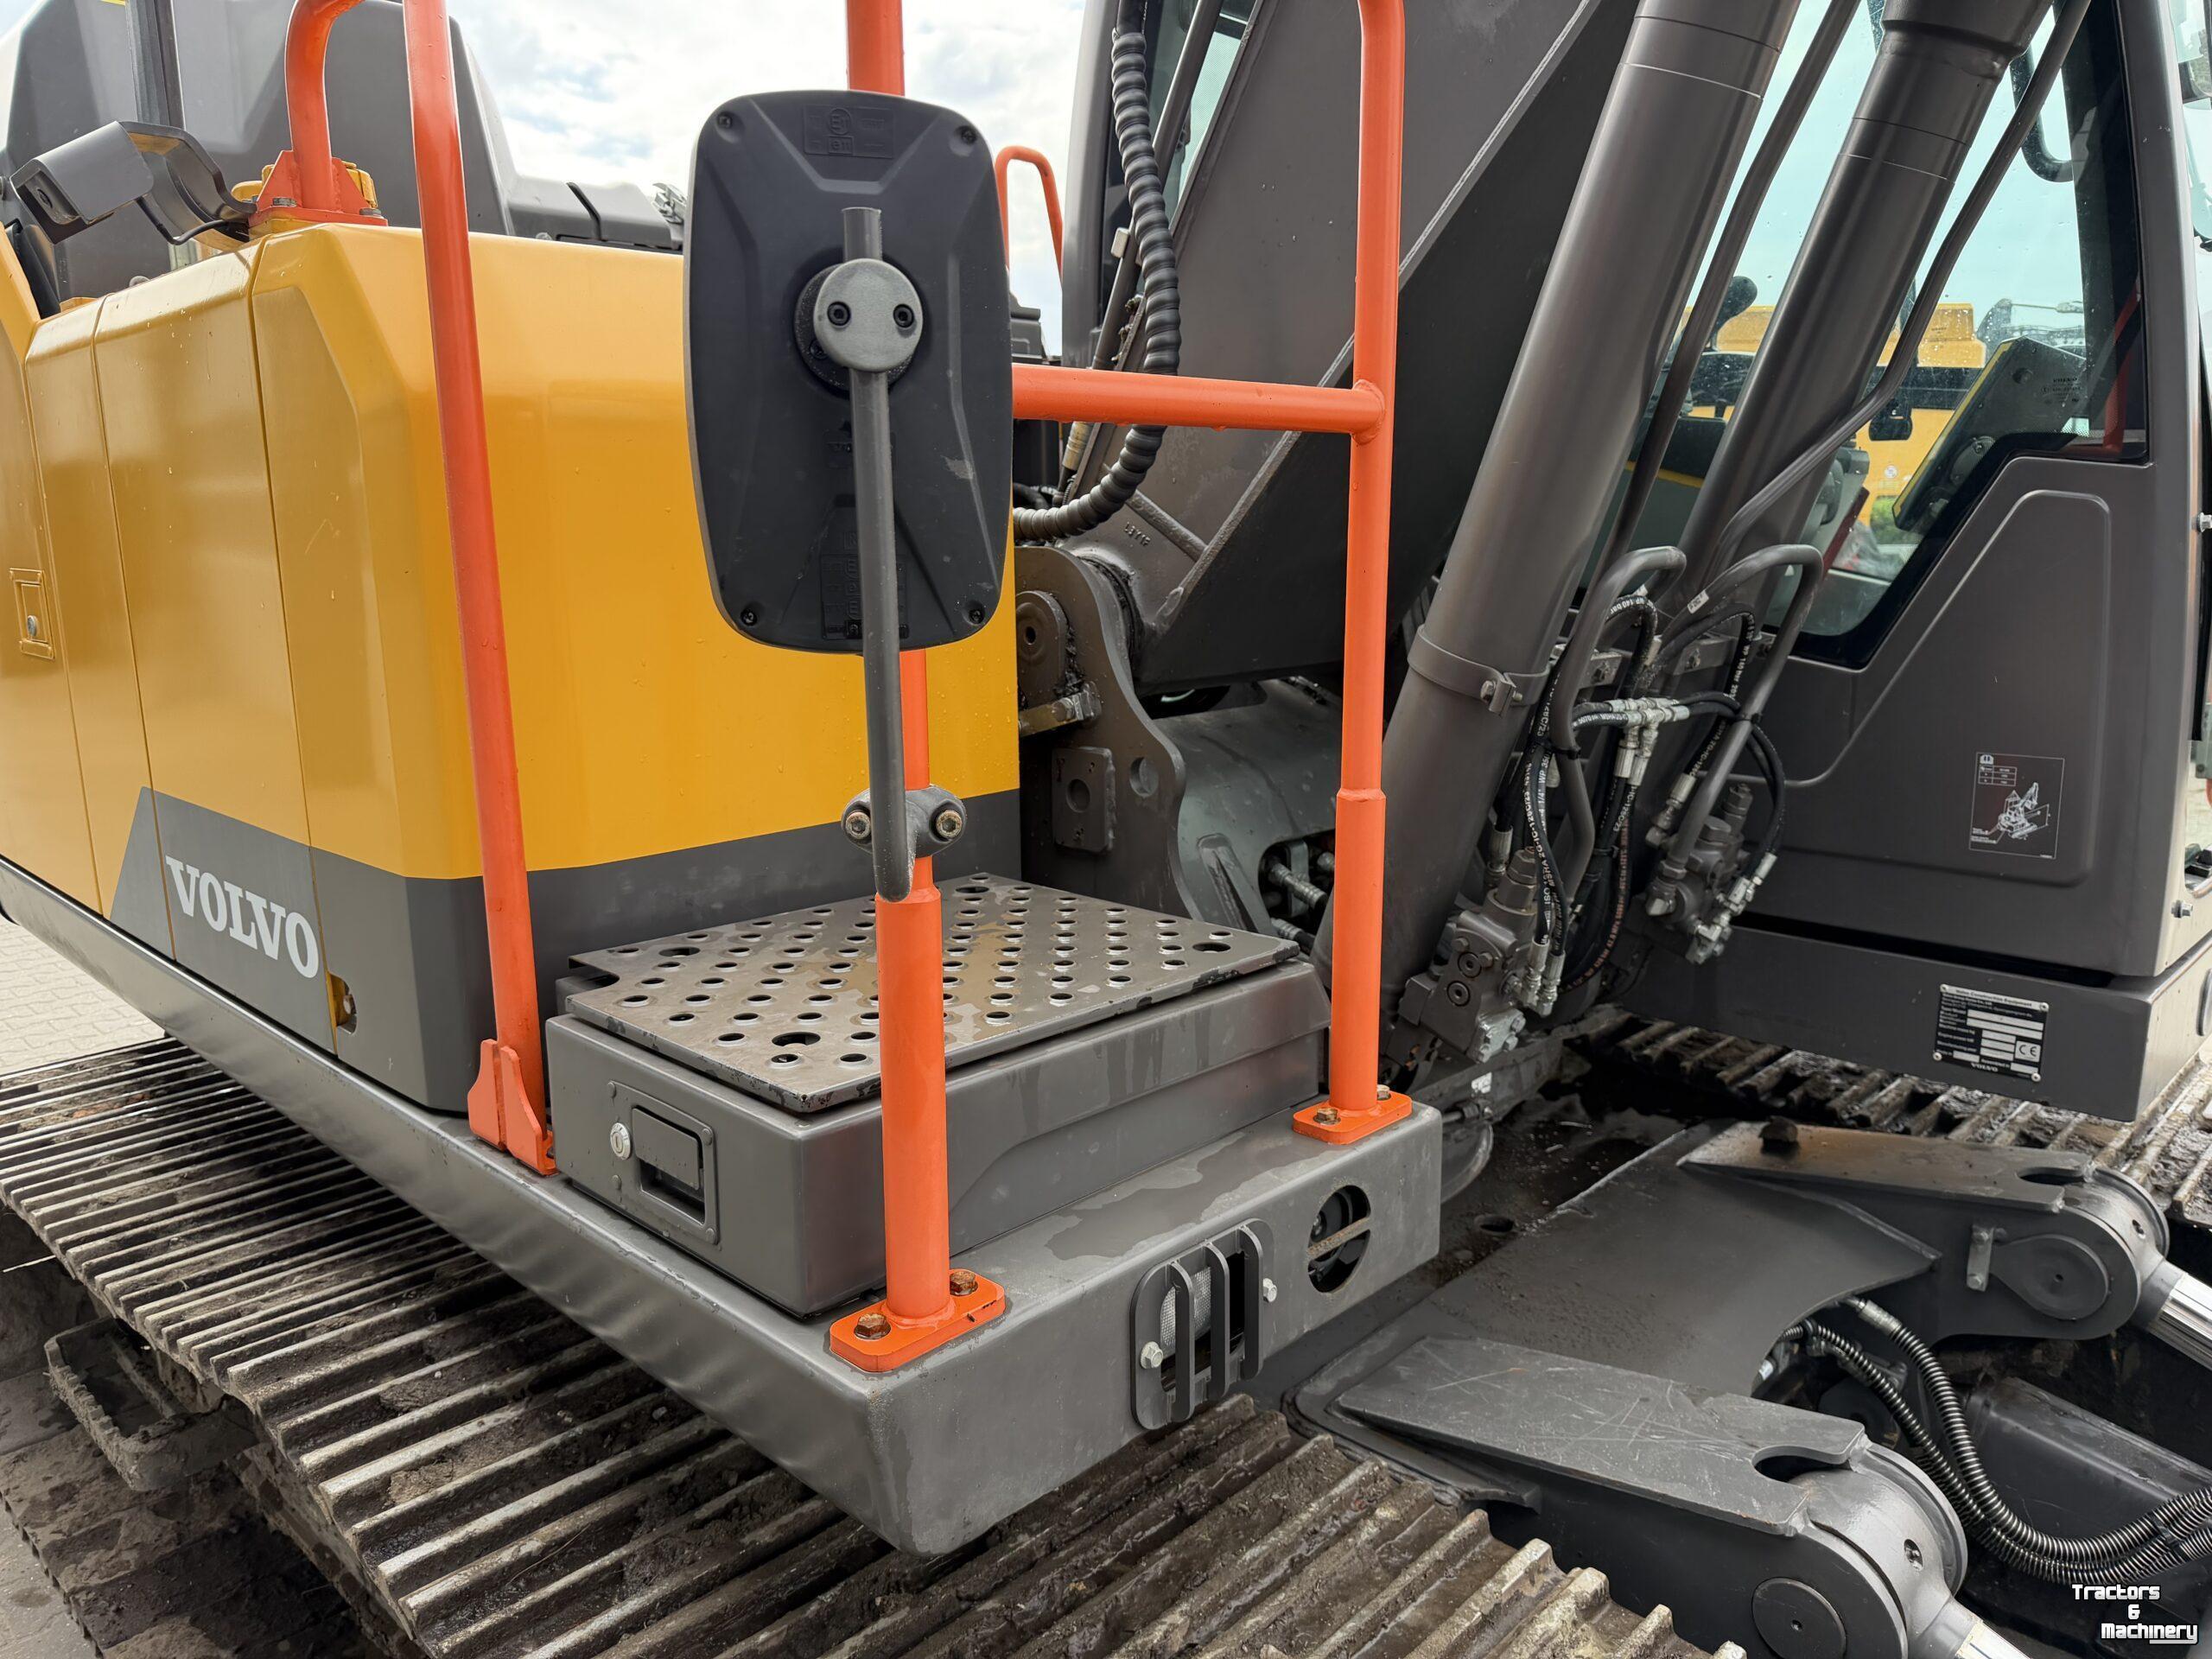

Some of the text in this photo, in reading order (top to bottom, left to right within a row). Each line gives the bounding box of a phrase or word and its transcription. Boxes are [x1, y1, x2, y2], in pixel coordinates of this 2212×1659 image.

[1538, 770, 1548, 785] WP
[1541, 859, 1556, 887] MSHA
[1543, 887, 1552, 905] ISO
[165, 855, 320, 979] VOLVO
[1970, 1062, 1999, 1073] VOLVO
